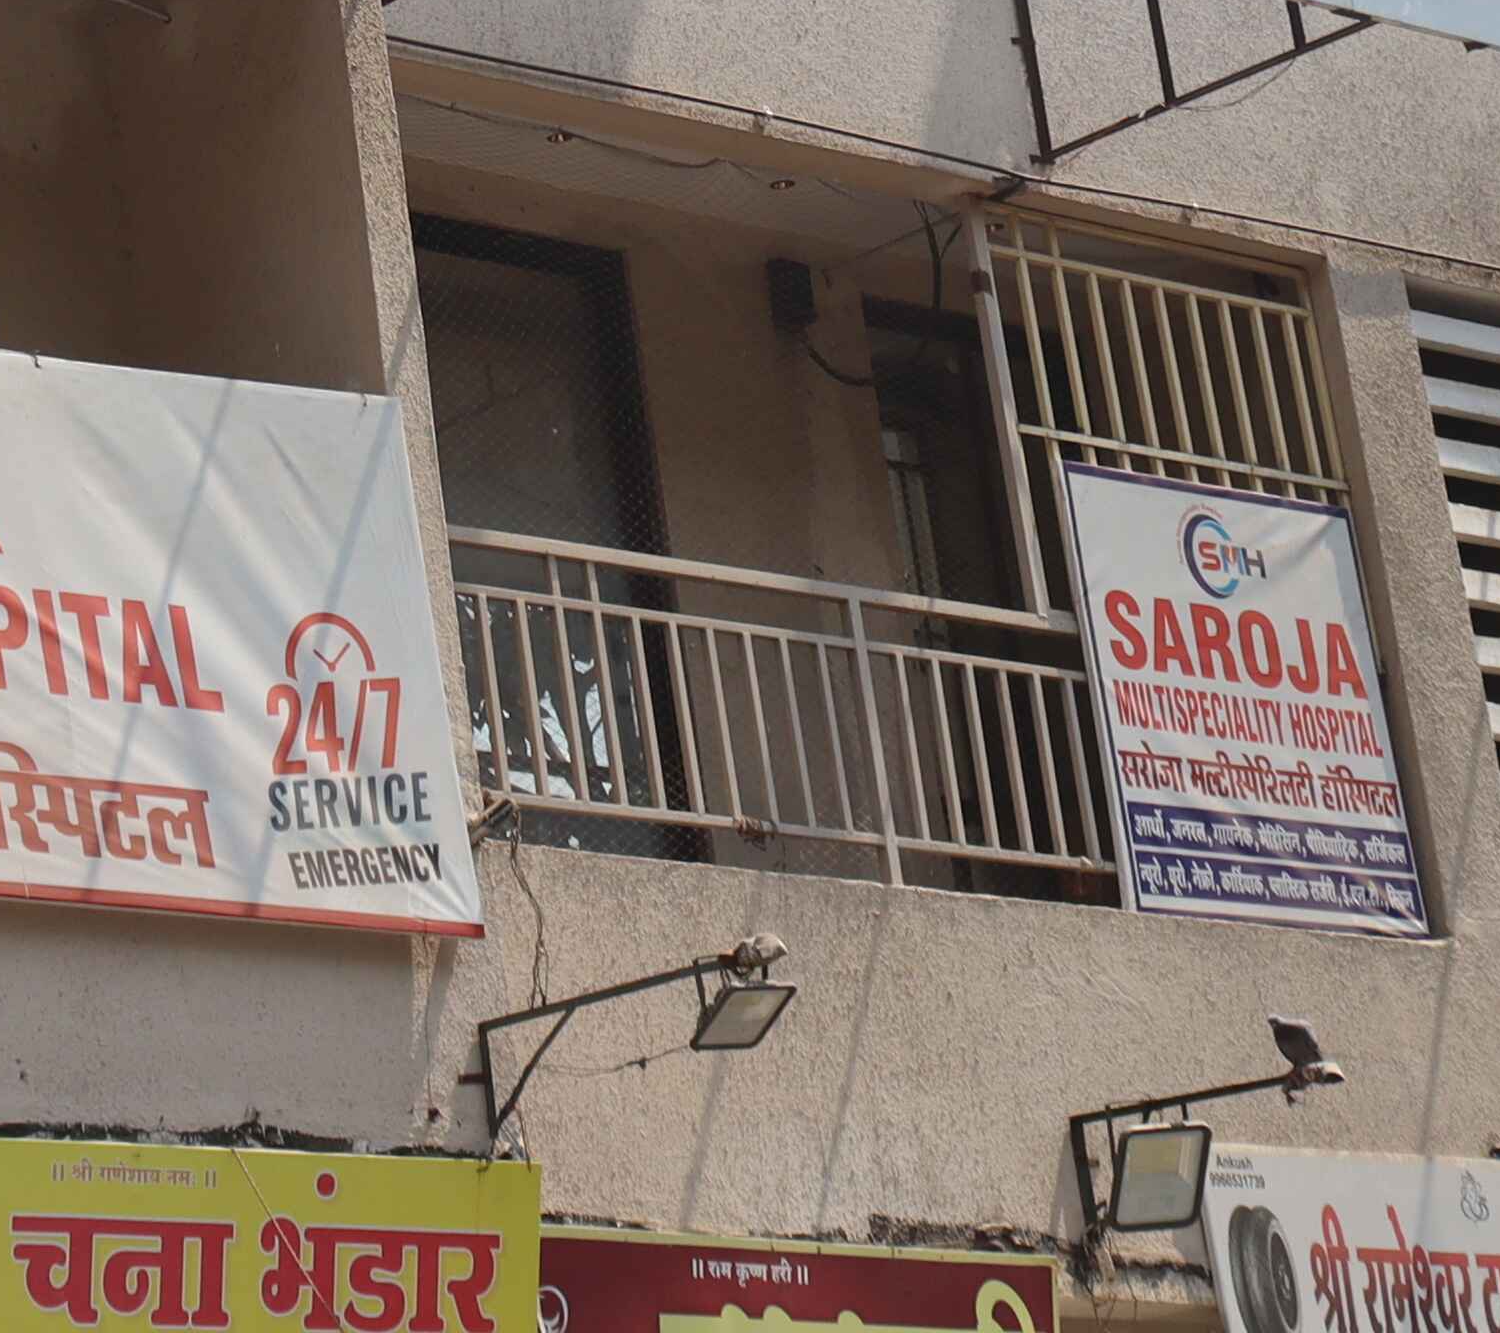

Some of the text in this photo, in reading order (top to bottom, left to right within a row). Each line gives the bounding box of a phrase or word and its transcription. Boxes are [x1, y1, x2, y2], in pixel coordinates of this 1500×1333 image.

[1198, 540, 1267, 580] SMH
[1104, 589, 1369, 701] SAROJA
[266, 677, 401, 776] 24/7
[1112, 678, 1384, 758] MULTISPECIALITY HOSPITAL
[268, 771, 432, 833] SERVICE
[1117, 740, 1187, 795] सरोजा
[1320, 765, 1401, 818] हॉस्पिटल
[288, 843, 443, 890] EMERGENCY
[71, 1158, 93, 1183] श्री
[11, 1215, 235, 1329] चना
[257, 1171, 502, 1333] भंडार
[708, 1261, 732, 1282] राम
[1309, 1203, 1359, 1333] श्री
[1355, 1203, 1473, 1333] रामेश्वर
